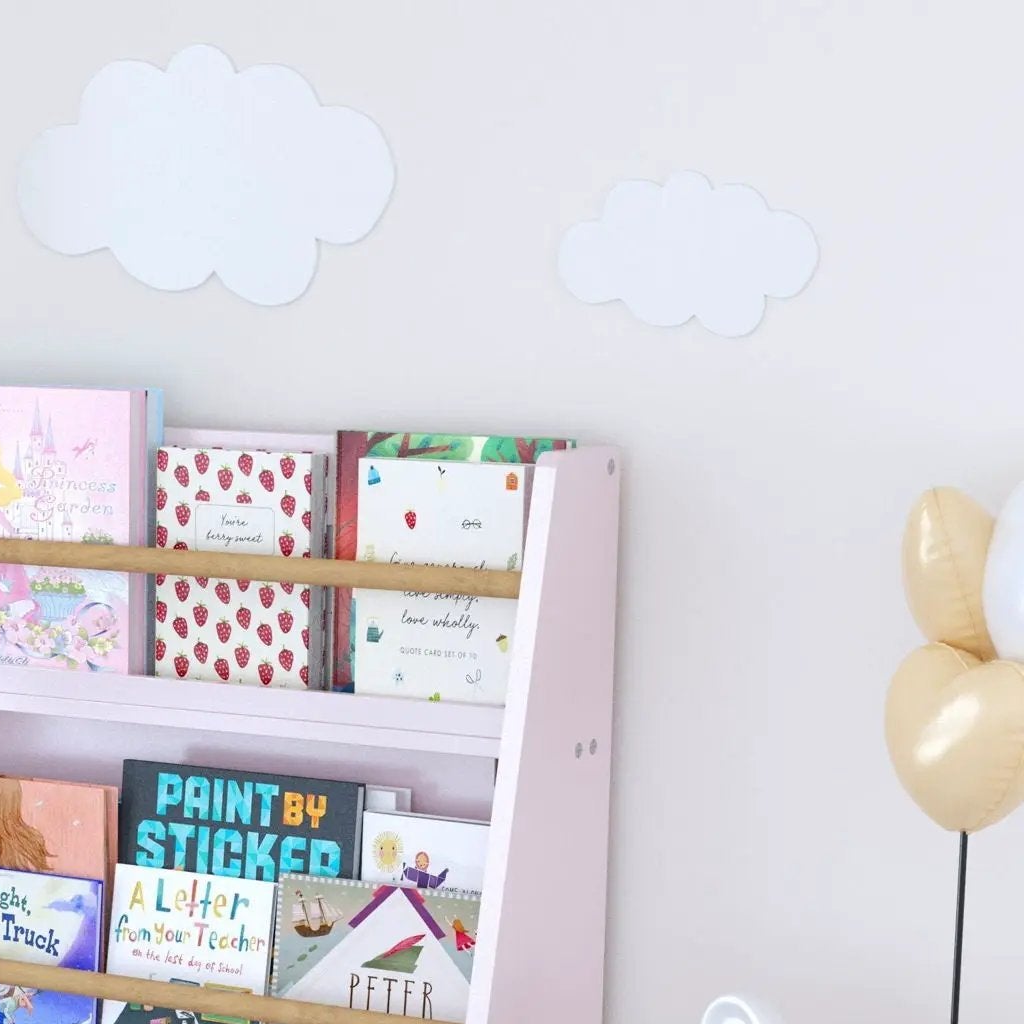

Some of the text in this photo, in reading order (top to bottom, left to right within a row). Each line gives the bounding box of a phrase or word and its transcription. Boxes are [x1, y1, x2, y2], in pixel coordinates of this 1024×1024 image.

[29, 495, 114, 522] Garden
[220, 513, 249, 527] You're
[206, 529, 263, 547] berry sweet
[401, 609, 480, 639] love wholly.
[400, 646, 422, 656] QUOTE
[424, 648, 442, 657] CARD
[444, 650, 456, 659] SET
[458, 651, 467, 660] OF
[156, 772, 328, 829] PAINT BY
[129, 878, 250, 920] A Letter
[1, 912, 60, 957] Truck
[115, 914, 151, 943] from
[194, 922, 266, 952] Teacher
[146, 951, 161, 963] the
[164, 950, 183, 965] last
[188, 956, 202, 972] day
[205, 961, 216, 973] of
